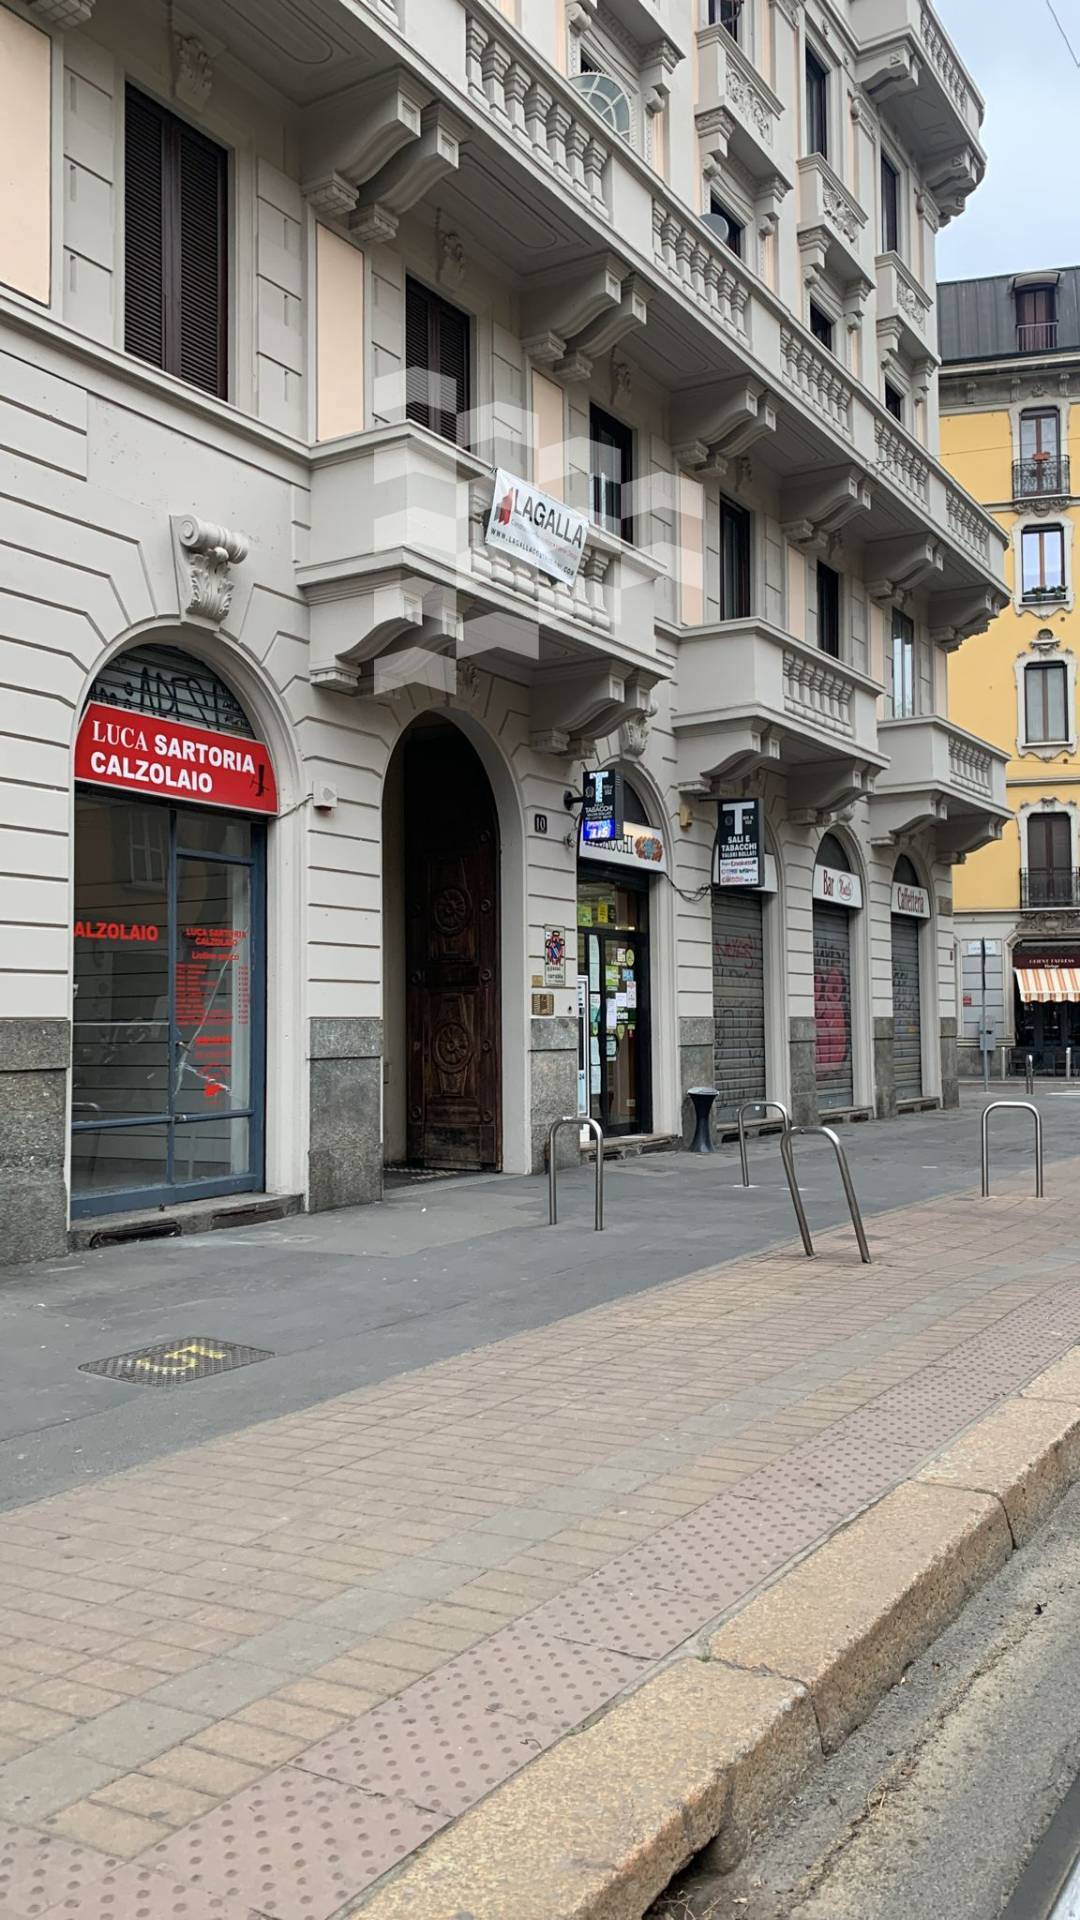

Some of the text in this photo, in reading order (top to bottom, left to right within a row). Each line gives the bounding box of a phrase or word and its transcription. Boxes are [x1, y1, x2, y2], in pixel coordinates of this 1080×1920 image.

[514, 489, 584, 549] LAGALLA
[92, 720, 256, 775] LUCA SARTORIA
[90, 751, 213, 793] CALZOLAIO
[589, 771, 609, 803] T
[722, 801, 755, 835] T
[721, 842, 757, 852] TABACCHI
[728, 834, 751, 844] SALI E
[823, 869, 834, 897] Bar
